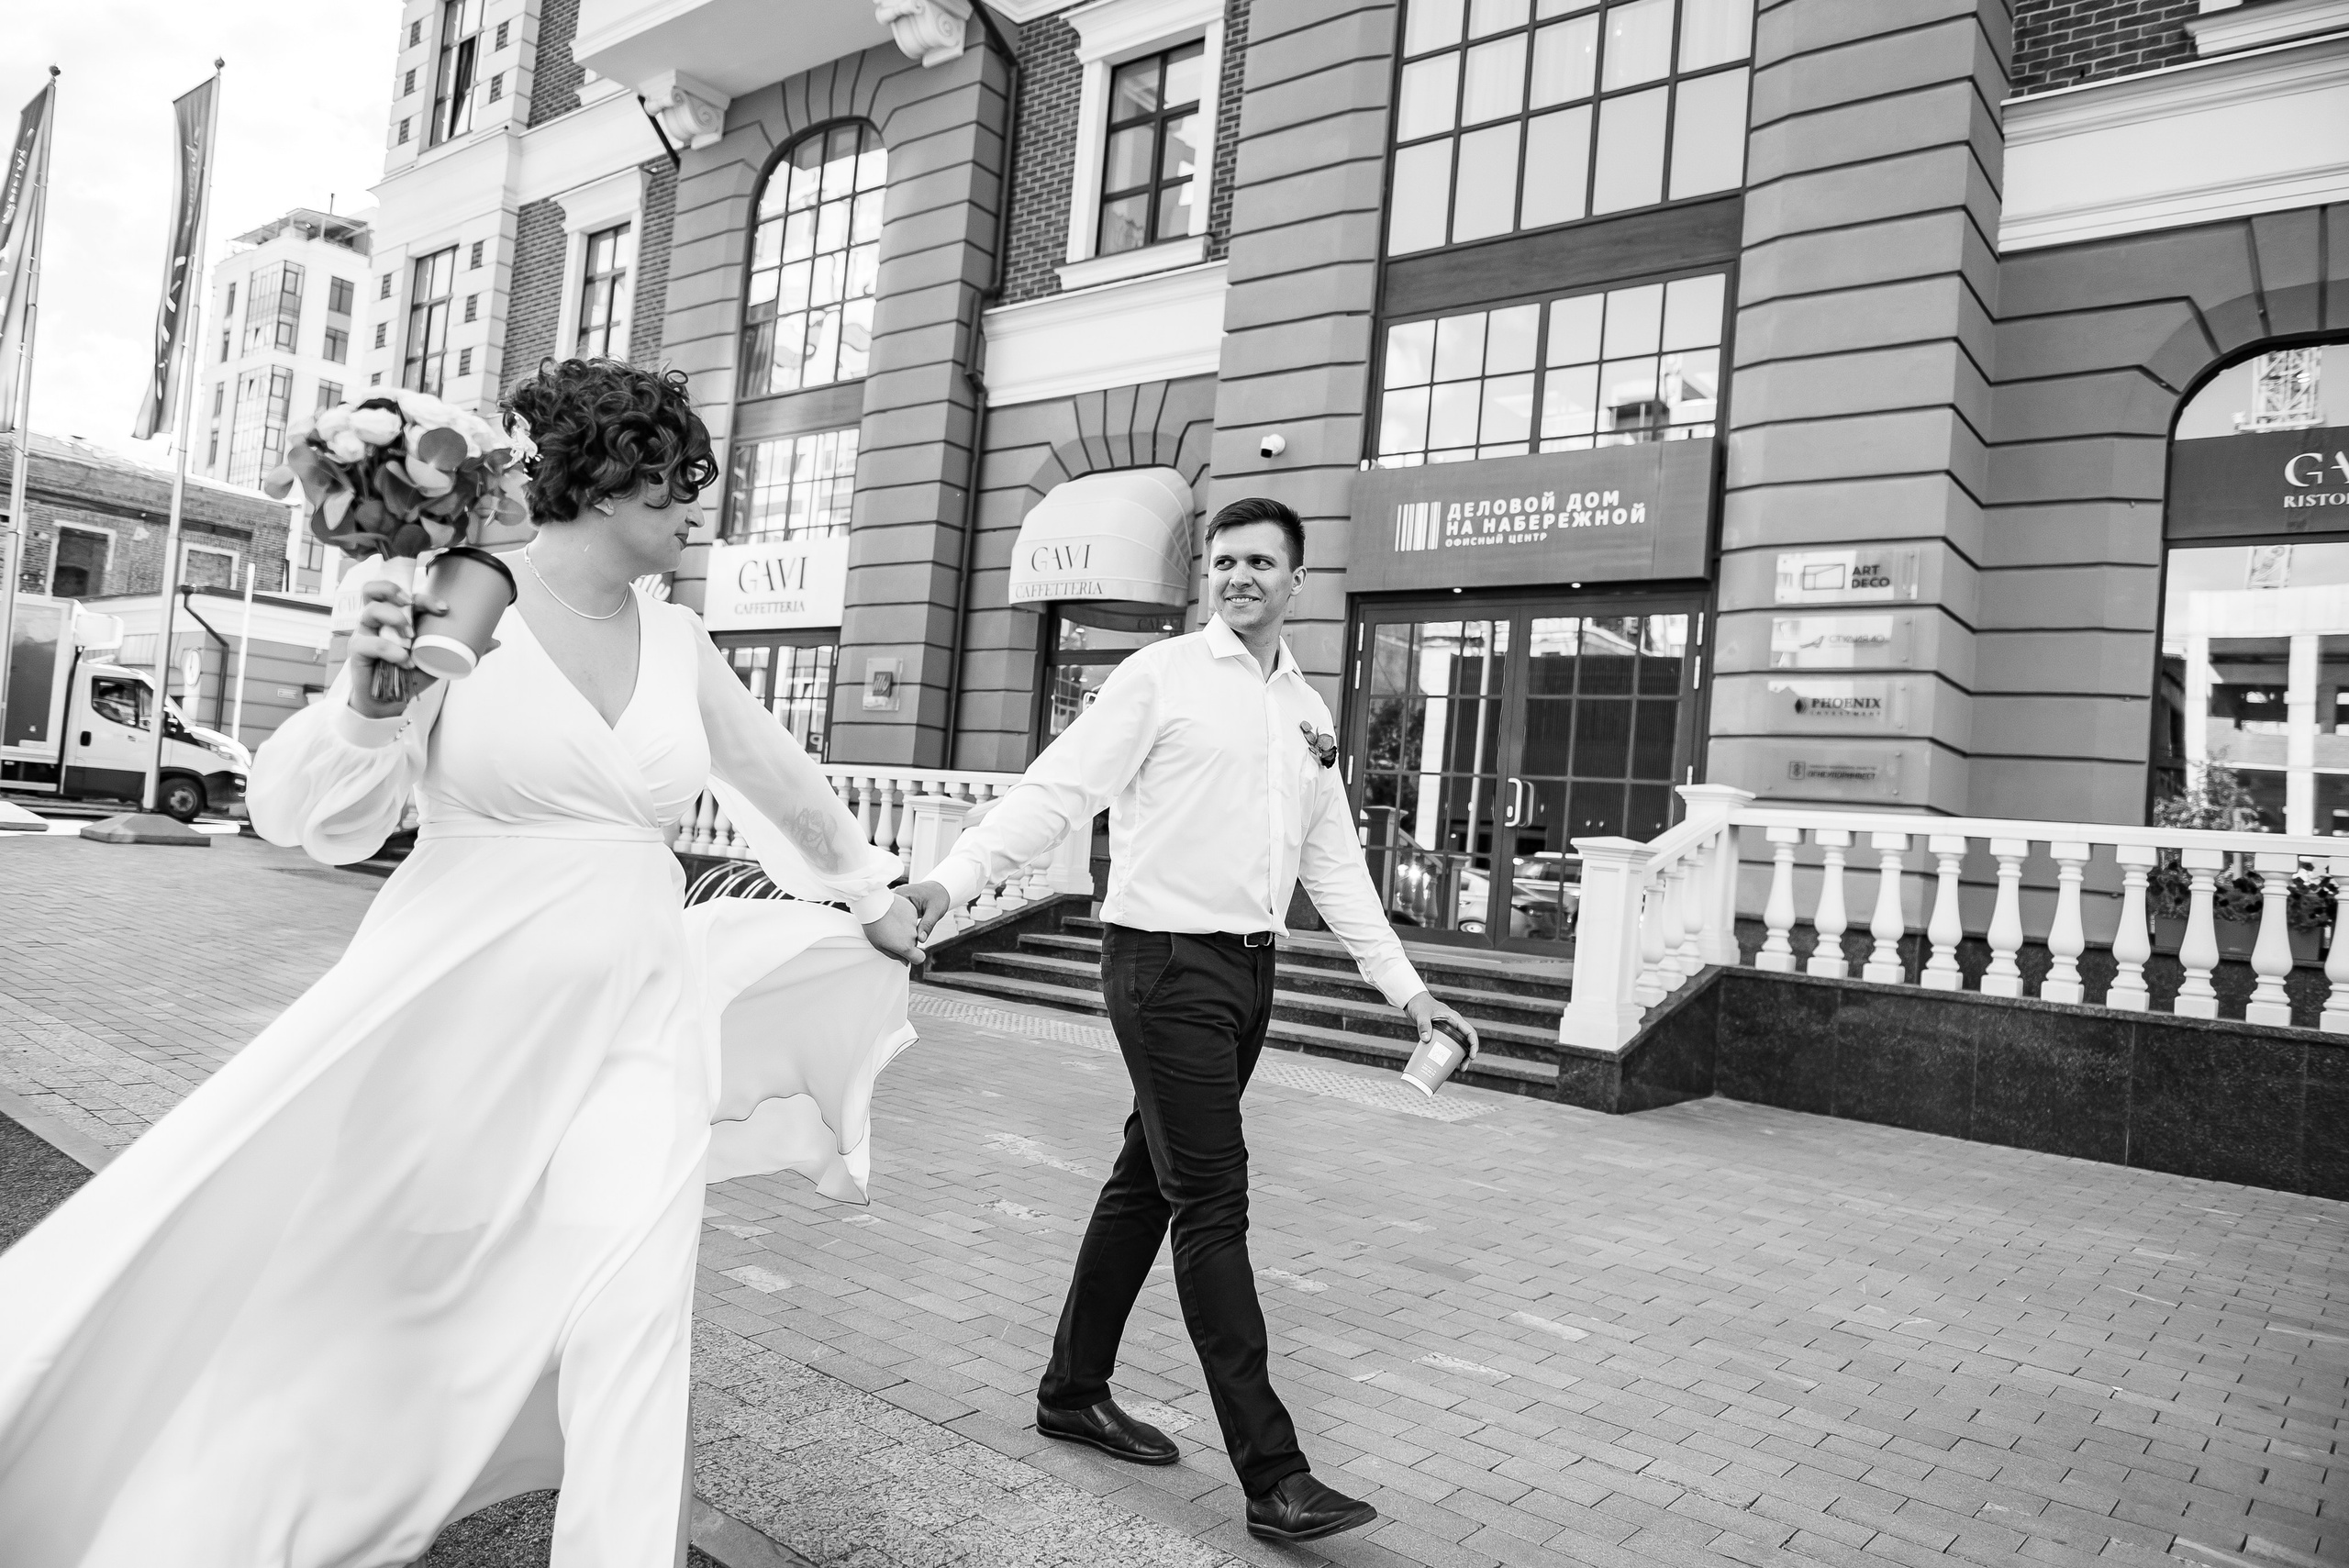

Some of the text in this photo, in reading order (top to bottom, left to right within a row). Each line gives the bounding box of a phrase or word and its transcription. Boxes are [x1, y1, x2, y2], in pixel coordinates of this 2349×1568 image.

[1447, 490, 1620, 521] ДЕЛОВОЙ ДОМ
[2283, 493, 2349, 508] RISTO
[1446, 502, 1646, 536] НА НАБЕРЕЖНОЙ
[1445, 532, 1547, 548] ОФИСНЫЙ ЦЕНТР
[1030, 543, 1092, 573] GAVI
[739, 556, 808, 595] GAVI
[1852, 564, 1880, 576] ART
[1015, 581, 1103, 598] CAFFETTERIA
[1851, 576, 1890, 589] DECO
[734, 600, 806, 616] CAFFETTERIA
[1811, 698, 1881, 709] PHOENIX
